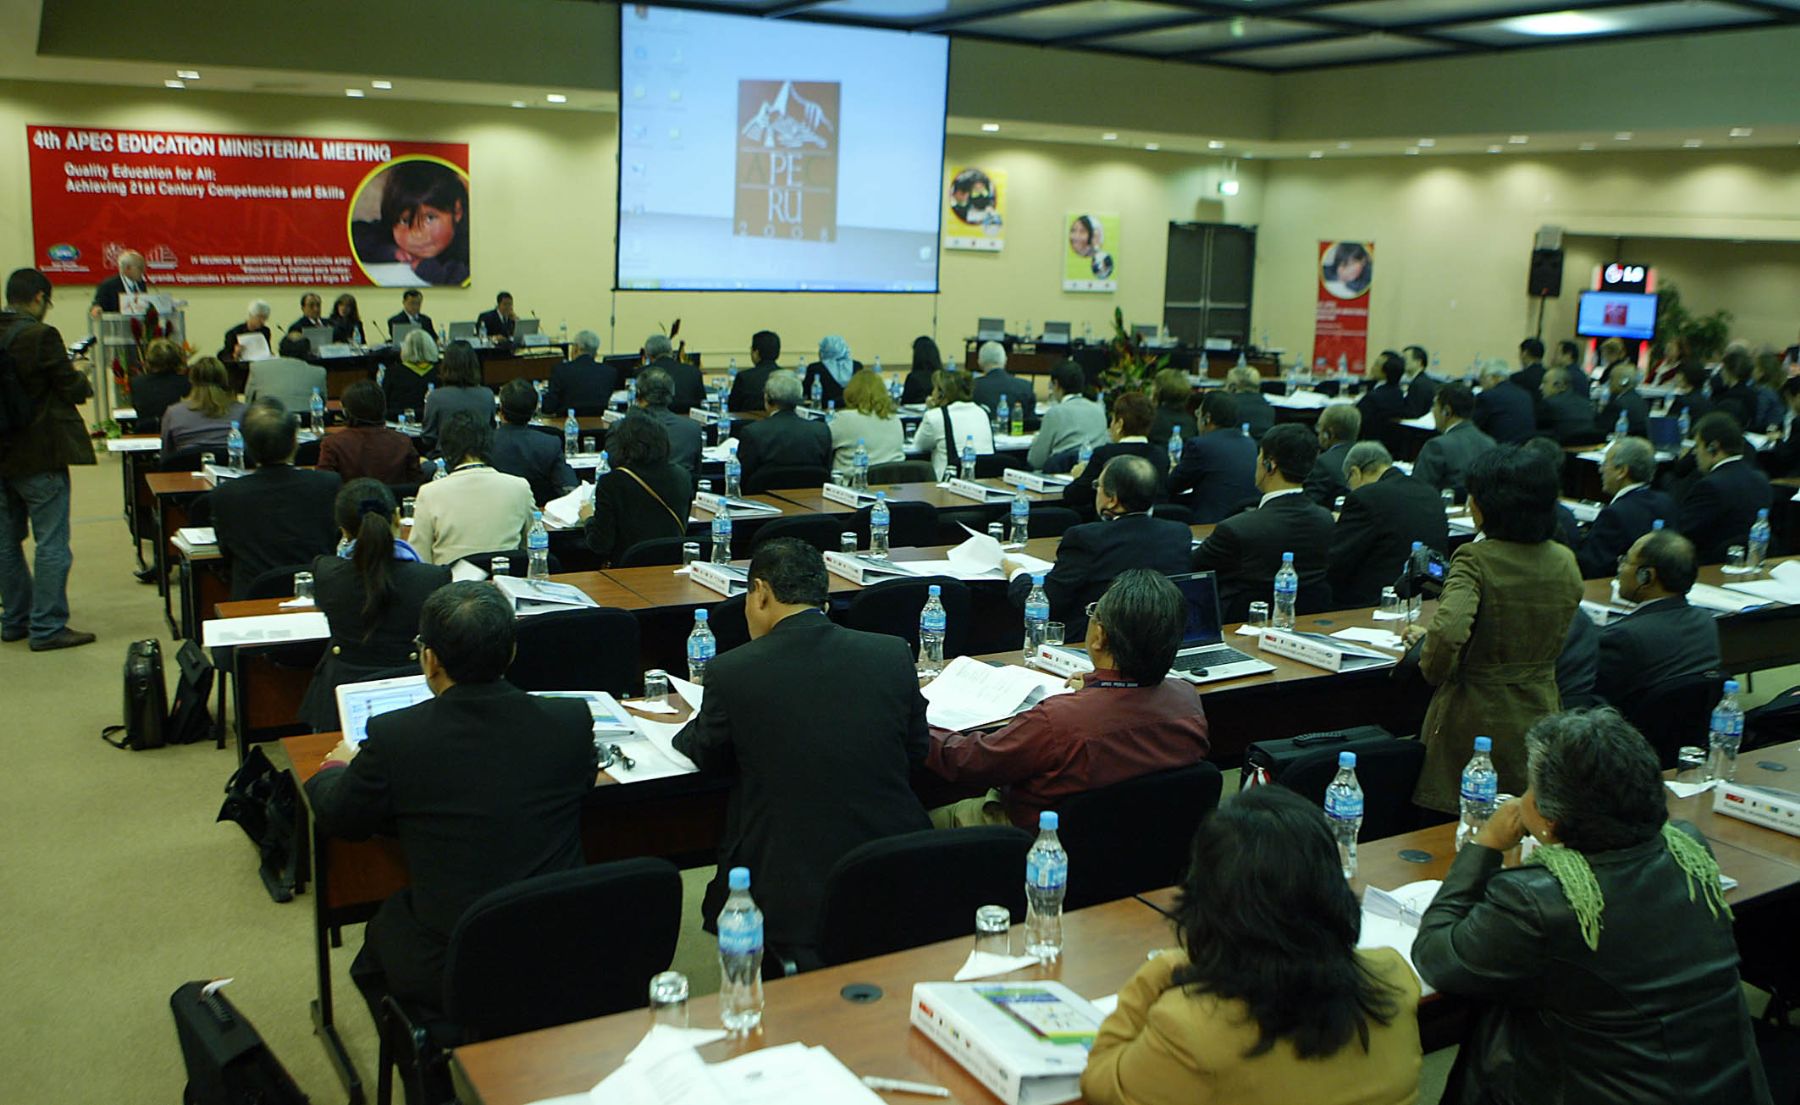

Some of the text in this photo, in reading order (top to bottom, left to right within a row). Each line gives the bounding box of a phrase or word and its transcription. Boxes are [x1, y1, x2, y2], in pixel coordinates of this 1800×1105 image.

[33, 130, 392, 162] 4th APEC EDUCATION MINISTERIAL MEETING
[64, 161, 216, 181] Quality Education for All:
[66, 178, 346, 200] Achieving 21st Century Competencies and Skills
